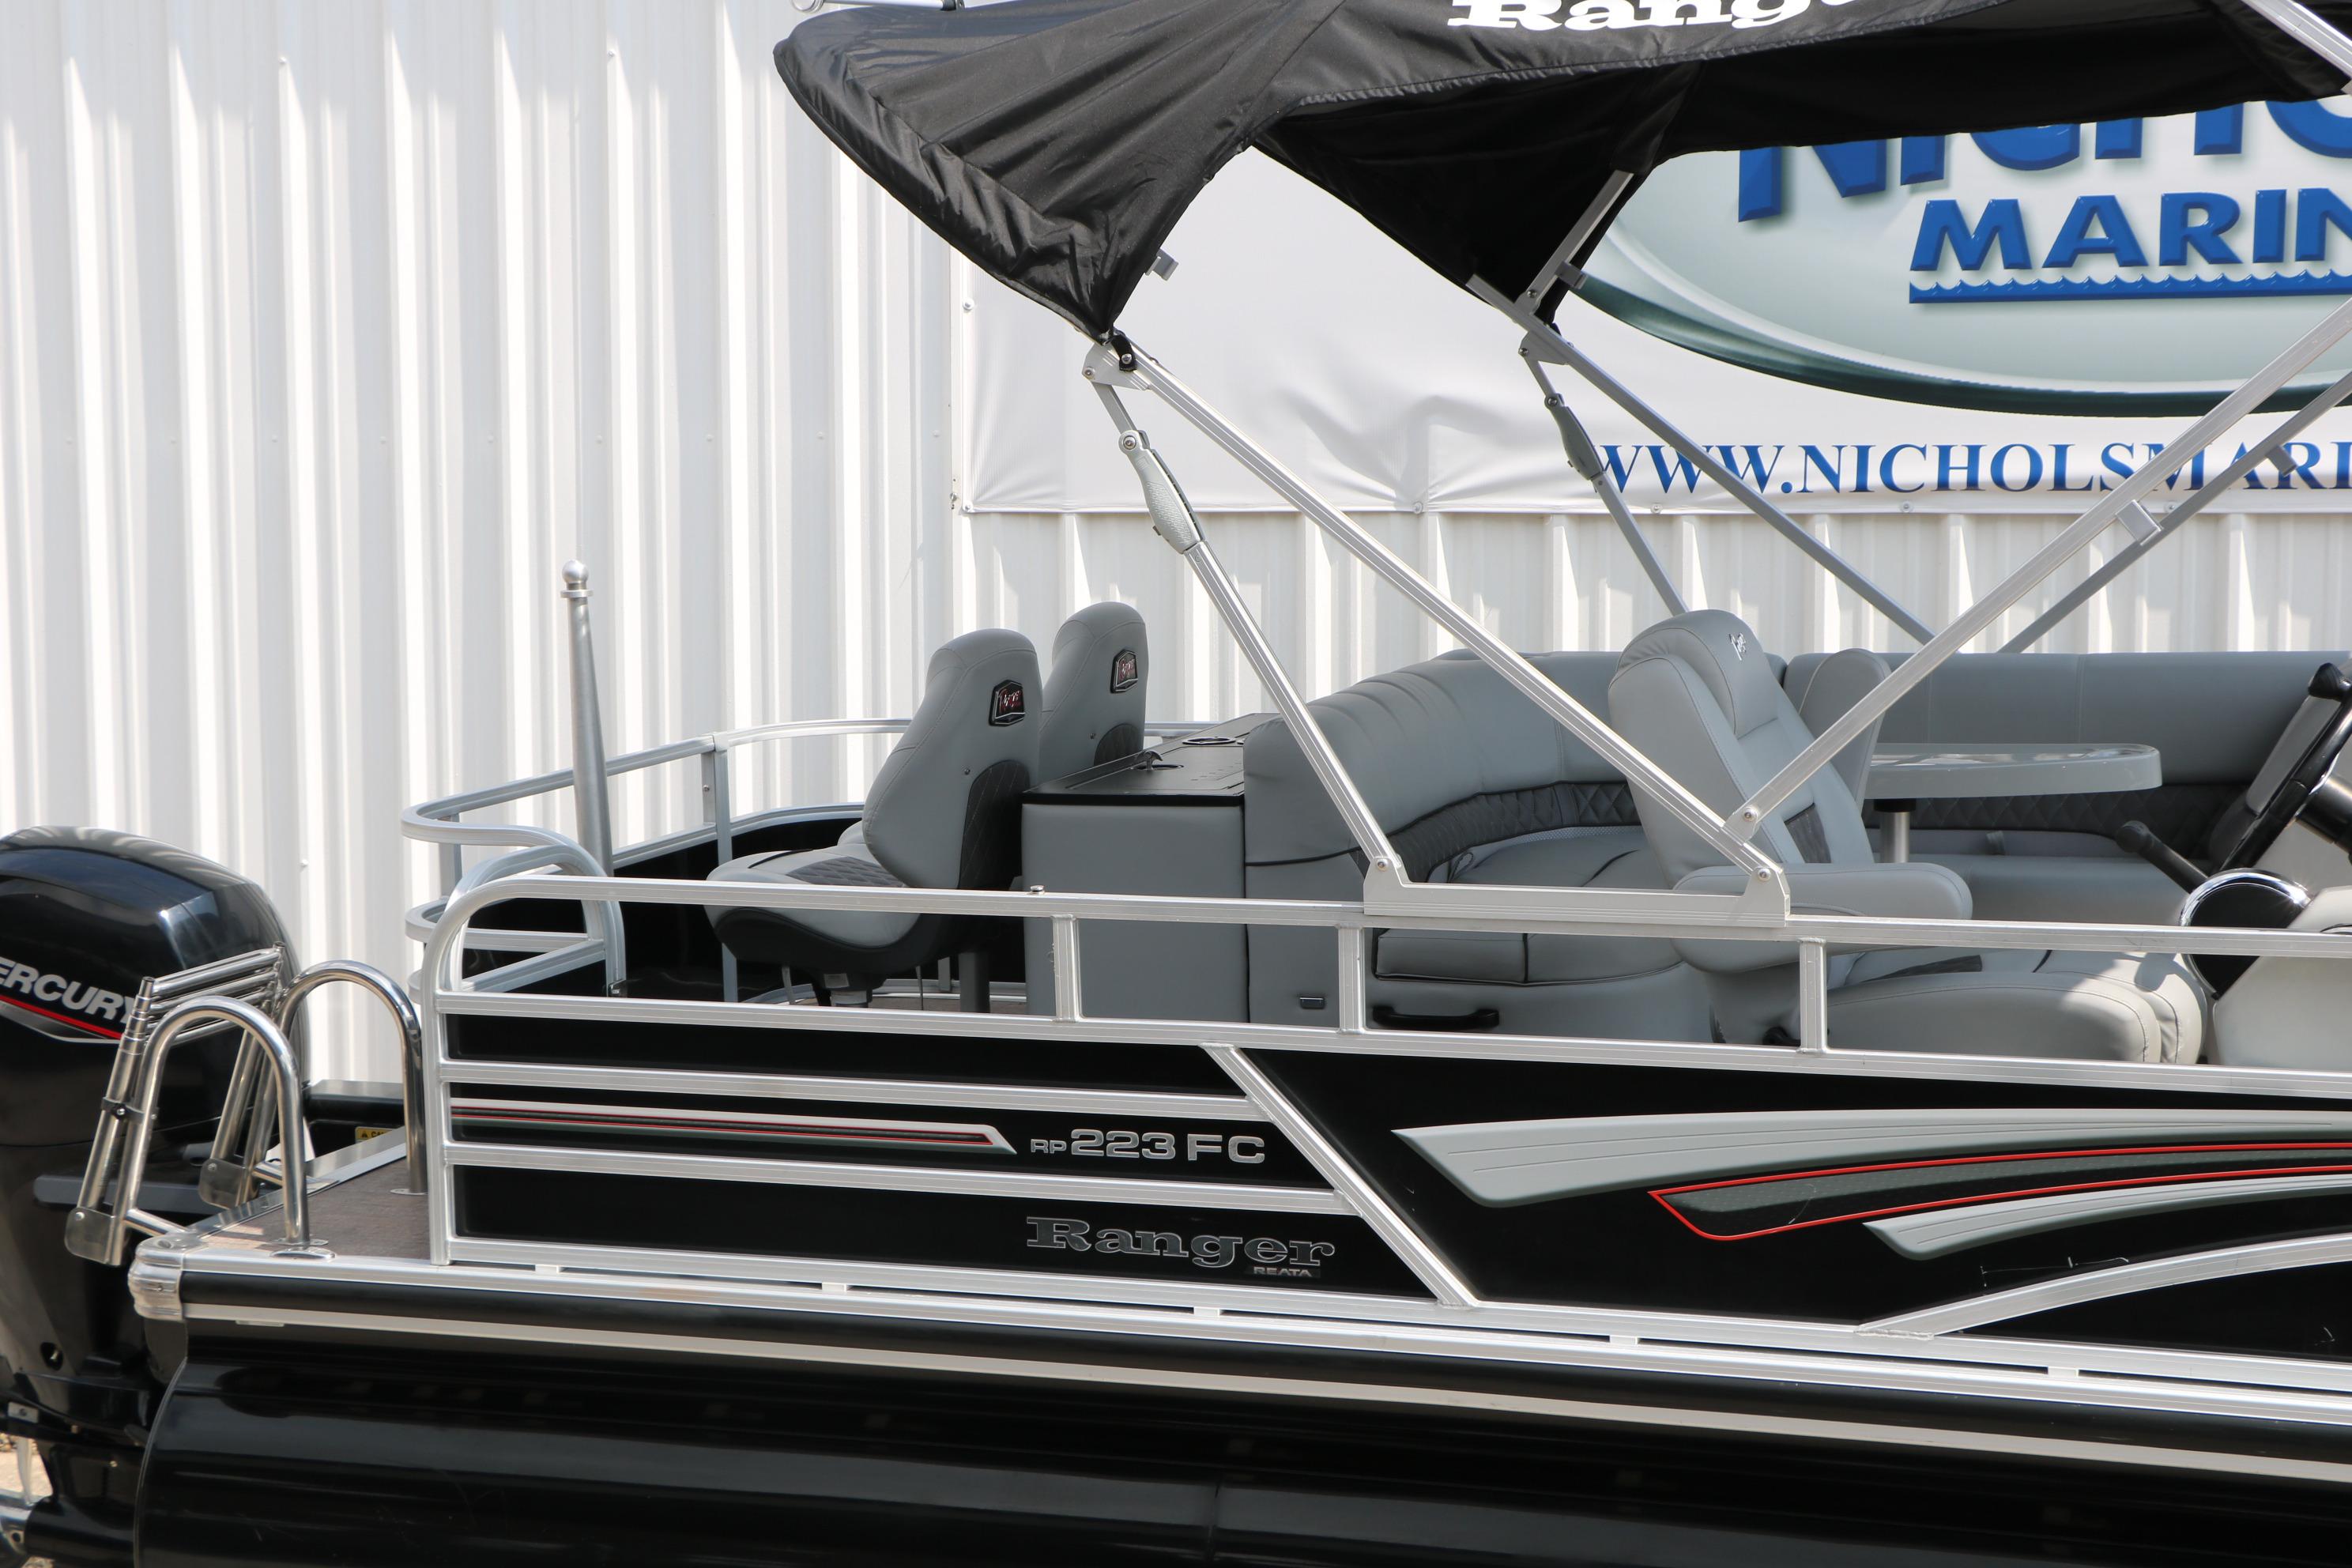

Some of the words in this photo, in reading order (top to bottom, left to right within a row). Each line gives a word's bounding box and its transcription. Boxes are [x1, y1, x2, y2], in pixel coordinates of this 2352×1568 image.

[1447, 0, 1856, 30] Rang
[1187, 1133, 1265, 1164] FC
[1027, 1216, 1336, 1268] Ranger
[1253, 1266, 1313, 1277] REATA
